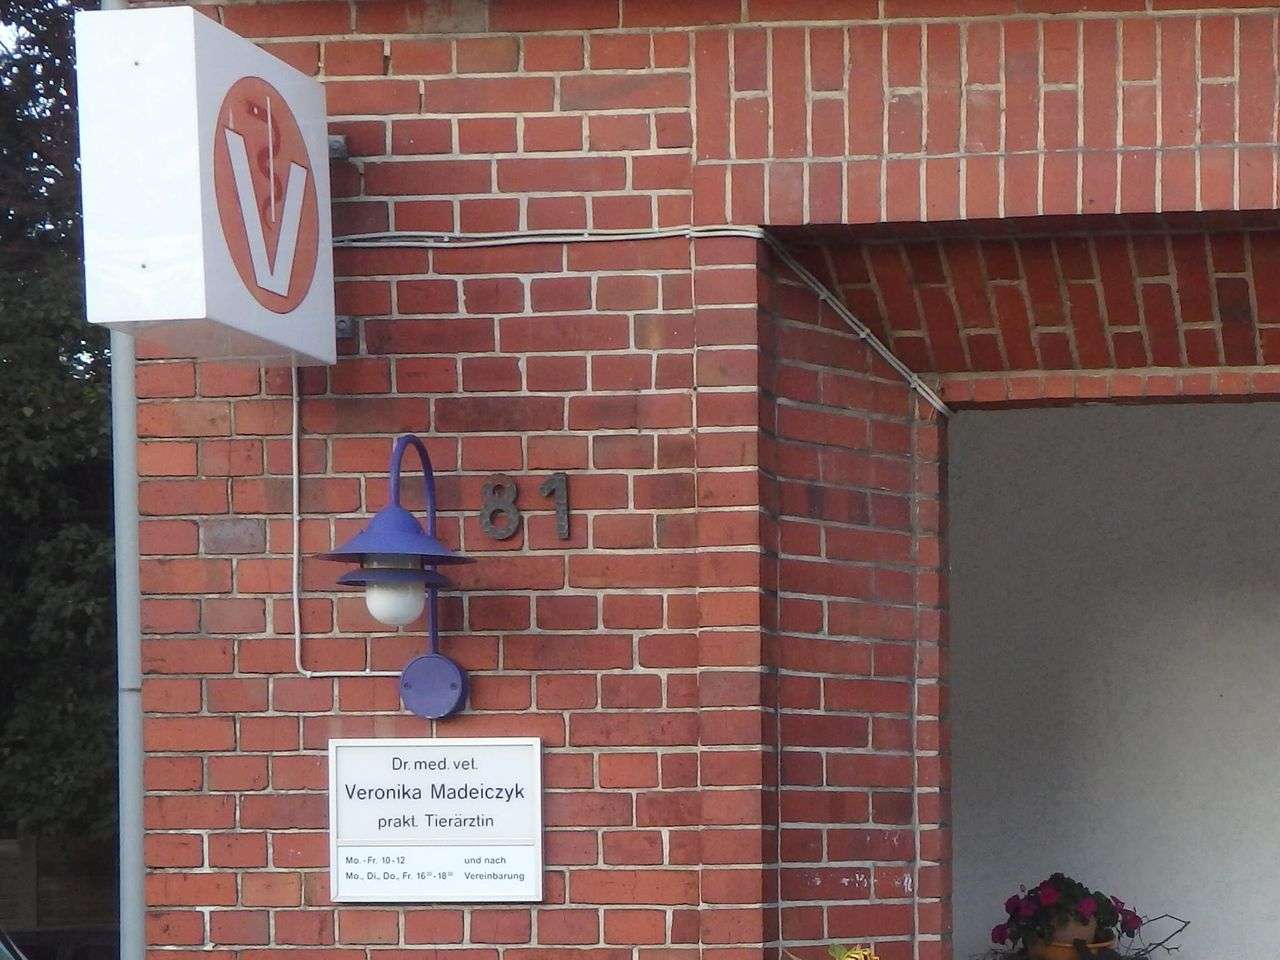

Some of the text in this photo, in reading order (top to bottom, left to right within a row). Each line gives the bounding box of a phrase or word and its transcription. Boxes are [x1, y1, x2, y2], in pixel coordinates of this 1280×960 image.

[479, 472, 570, 540] 81
[453, 757, 478, 770] vet.
[345, 784, 422, 799] Veronika
[378, 814, 494, 830] prakt. Tierärztin
[464, 856, 506, 864] und nach
[464, 872, 525, 881] Vereinbarung
